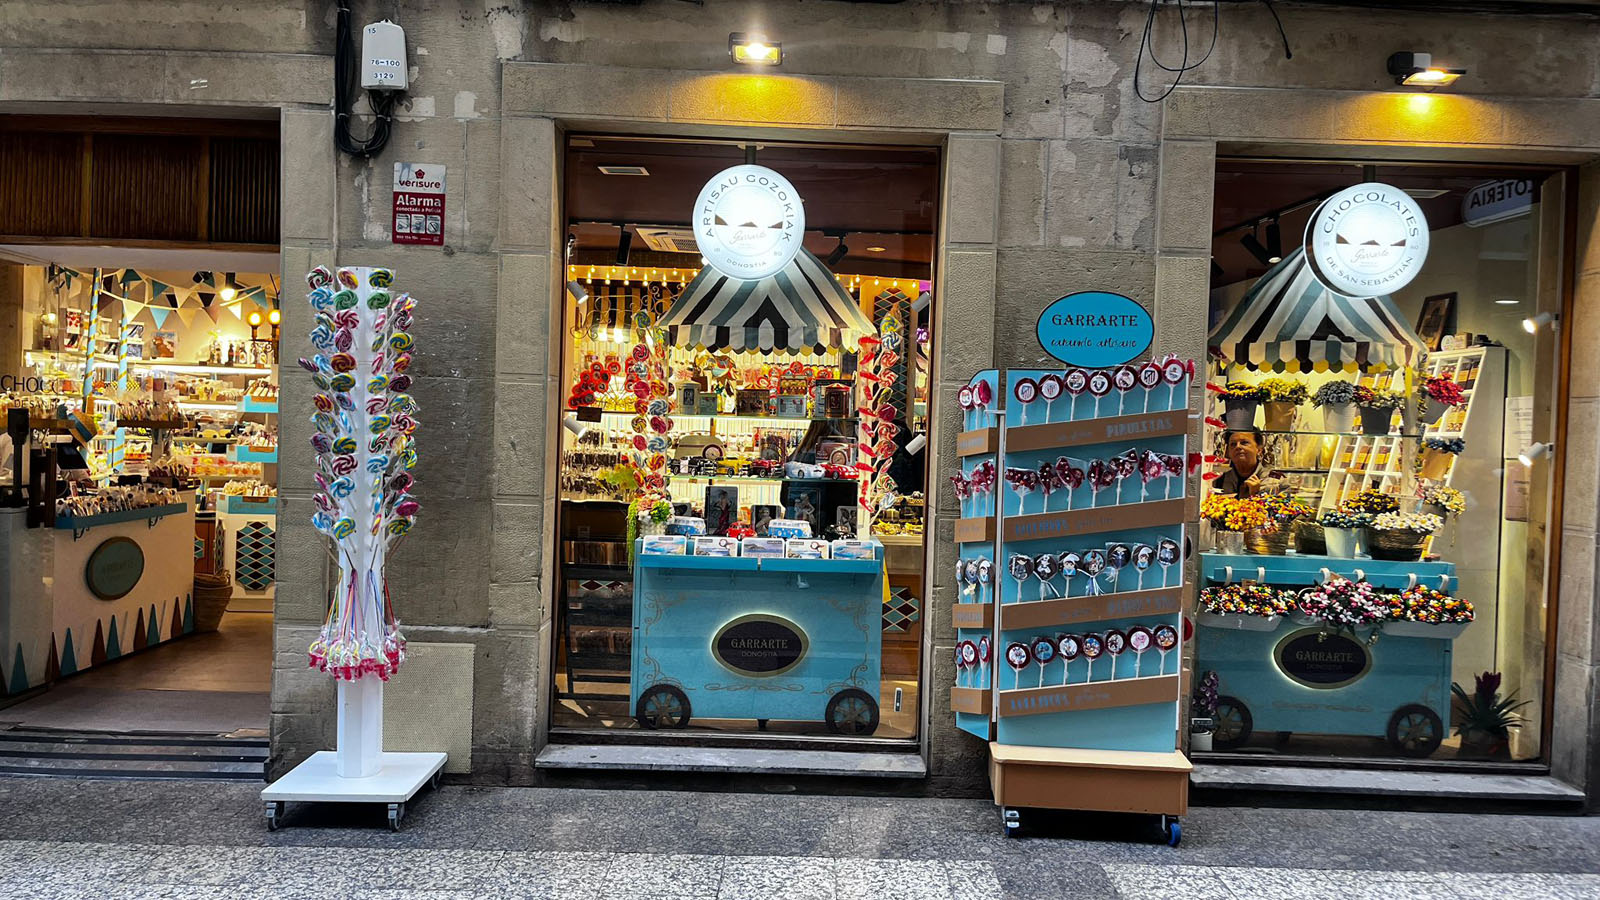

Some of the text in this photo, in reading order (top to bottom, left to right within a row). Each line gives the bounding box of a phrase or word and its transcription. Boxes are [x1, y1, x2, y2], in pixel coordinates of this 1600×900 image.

[371, 59, 400, 67] 76-100
[399, 180, 441, 189] verisure
[397, 194, 441, 207] Alarma
[703, 175, 794, 242] ARTISAU GOZOKIAK
[1323, 192, 1419, 237] CHOCOLATES
[726, 258, 767, 268] DONOSTIA
[1326, 256, 1338, 271] DE
[1337, 269, 1358, 284] SAN
[1052, 314, 1138, 327] GARRARTE
[731, 638, 788, 649] GARRARTE
[1296, 650, 1353, 662] GARRARTE
